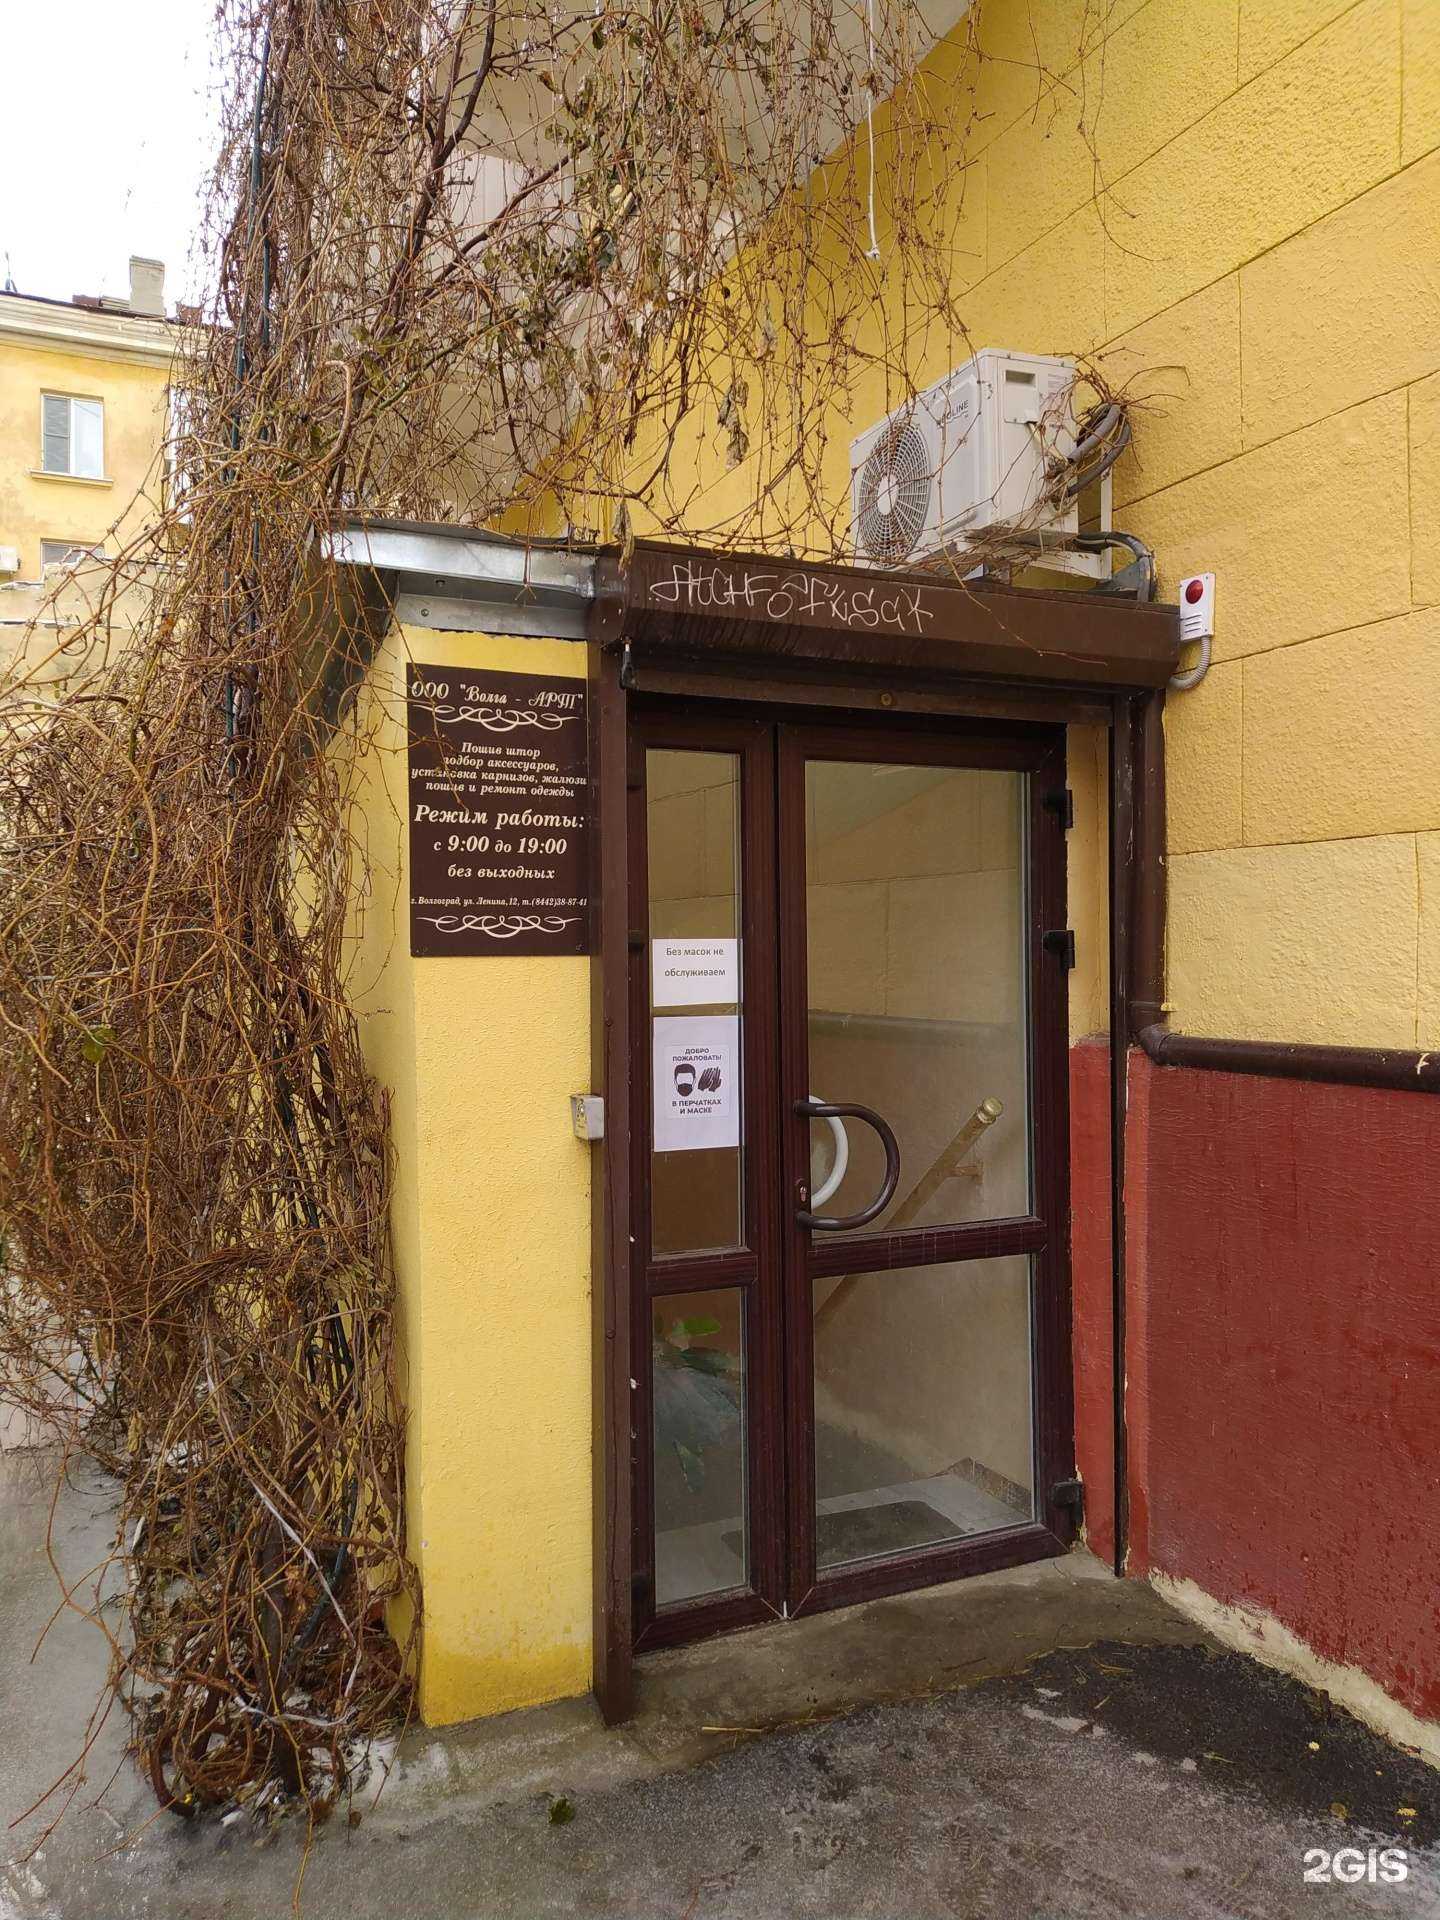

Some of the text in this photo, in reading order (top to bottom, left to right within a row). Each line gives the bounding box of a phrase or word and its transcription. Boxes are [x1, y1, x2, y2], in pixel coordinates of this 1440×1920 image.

[411, 680, 449, 699] ООО
[460, 684, 507, 704] "Волга
[461, 742, 541, 759] Пошив штор
[487, 759, 559, 773] аксессуаров,
[481, 769, 538, 783] карнизов,
[541, 774, 587, 785] жалюзи
[468, 784, 476, 792] и
[480, 785, 527, 796] ремонт
[530, 786, 575, 797] одежды
[414, 804, 585, 830] Режим работы:
[433, 834, 568, 855] с 9:00 до 19:00
[447, 864, 556, 879] без выходных
[418, 896, 461, 907] Волгоград,
[463, 898, 475, 907] ул.
[666, 947, 682, 956] Без
[664, 967, 726, 978] обслуживаем
[684, 1047, 711, 1055] ДОБРО
[678, 1098, 722, 1107] ПЕРЧАТКАХ
[687, 1106, 713, 1114] МАСКЕ
